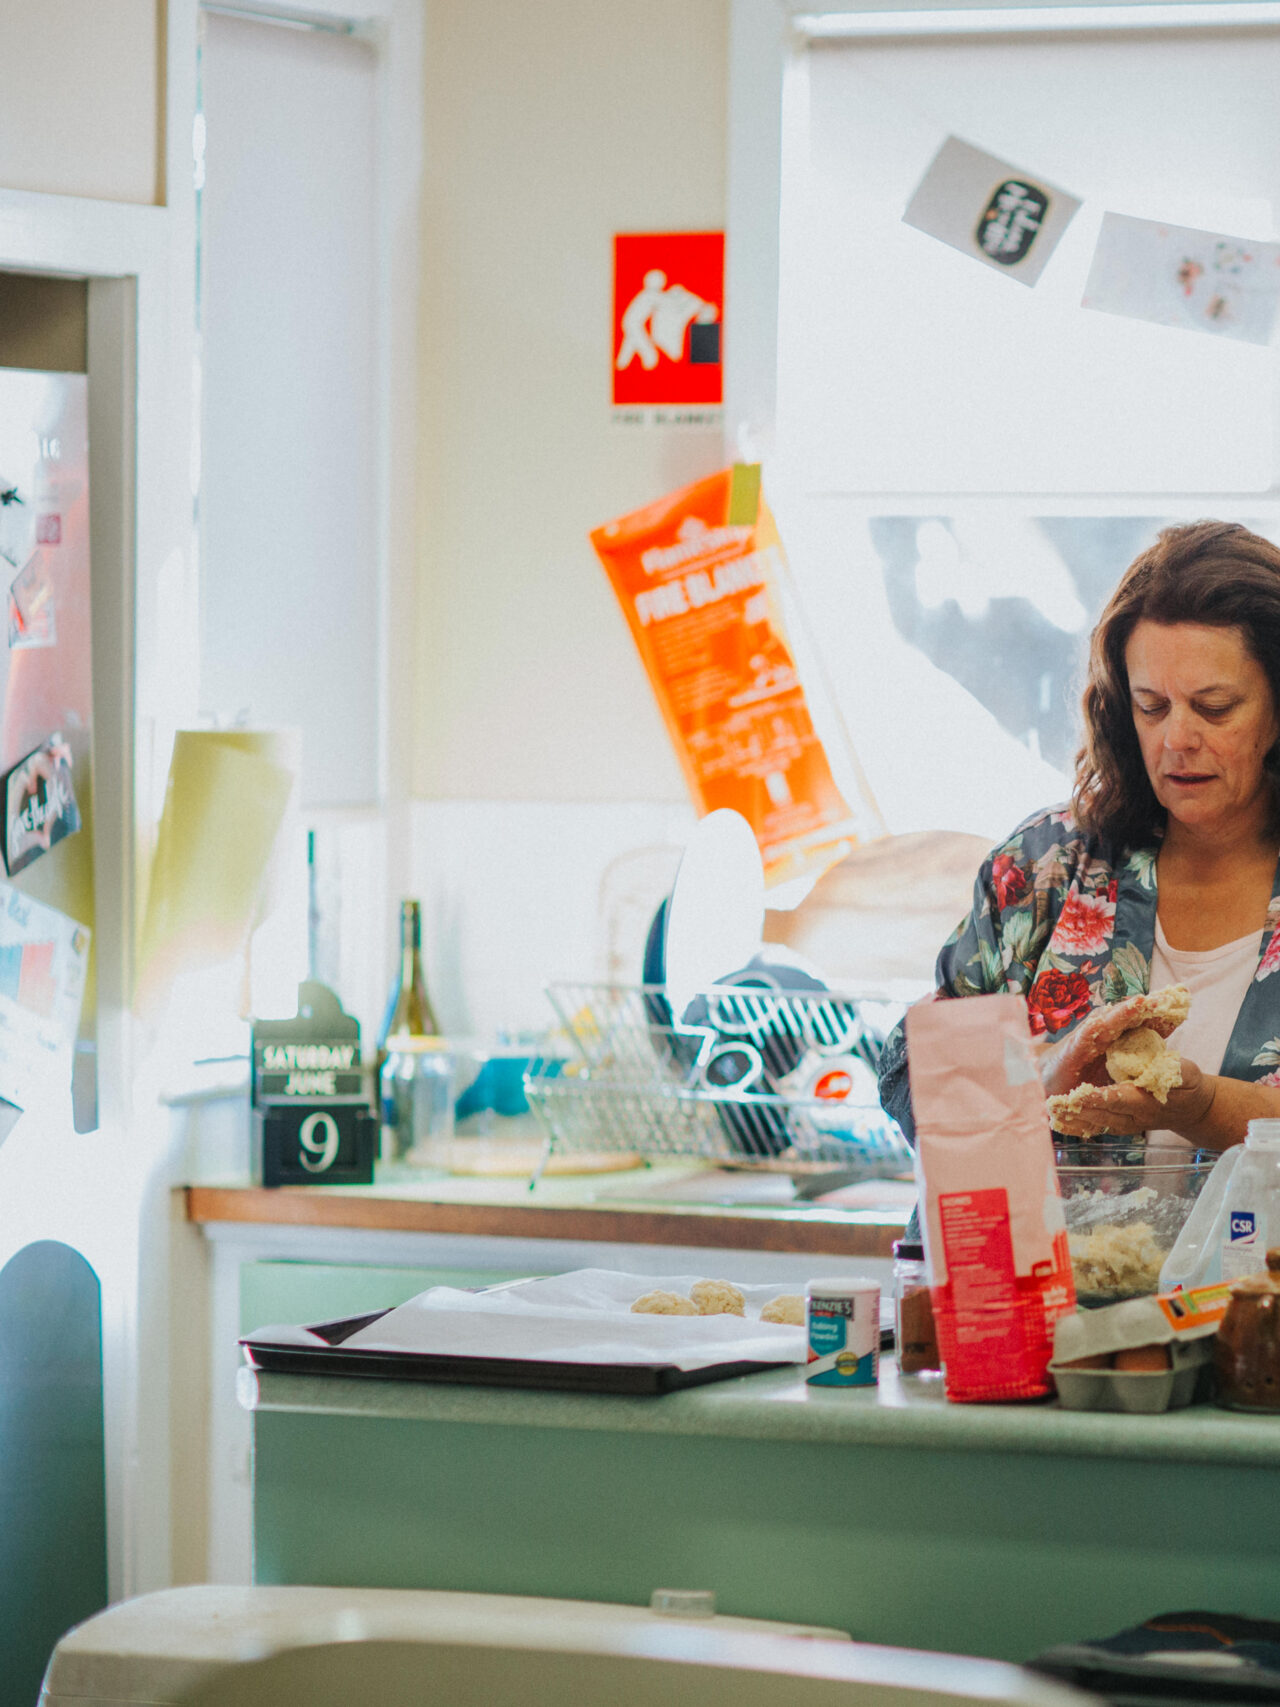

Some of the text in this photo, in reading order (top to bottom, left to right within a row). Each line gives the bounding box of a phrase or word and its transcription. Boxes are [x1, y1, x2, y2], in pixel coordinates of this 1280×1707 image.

[263, 1044, 355, 1070] SATURDAY
[284, 1070, 337, 1096] JUNE
[299, 1111, 340, 1173] 9
[1231, 1219, 1253, 1234] CSR
